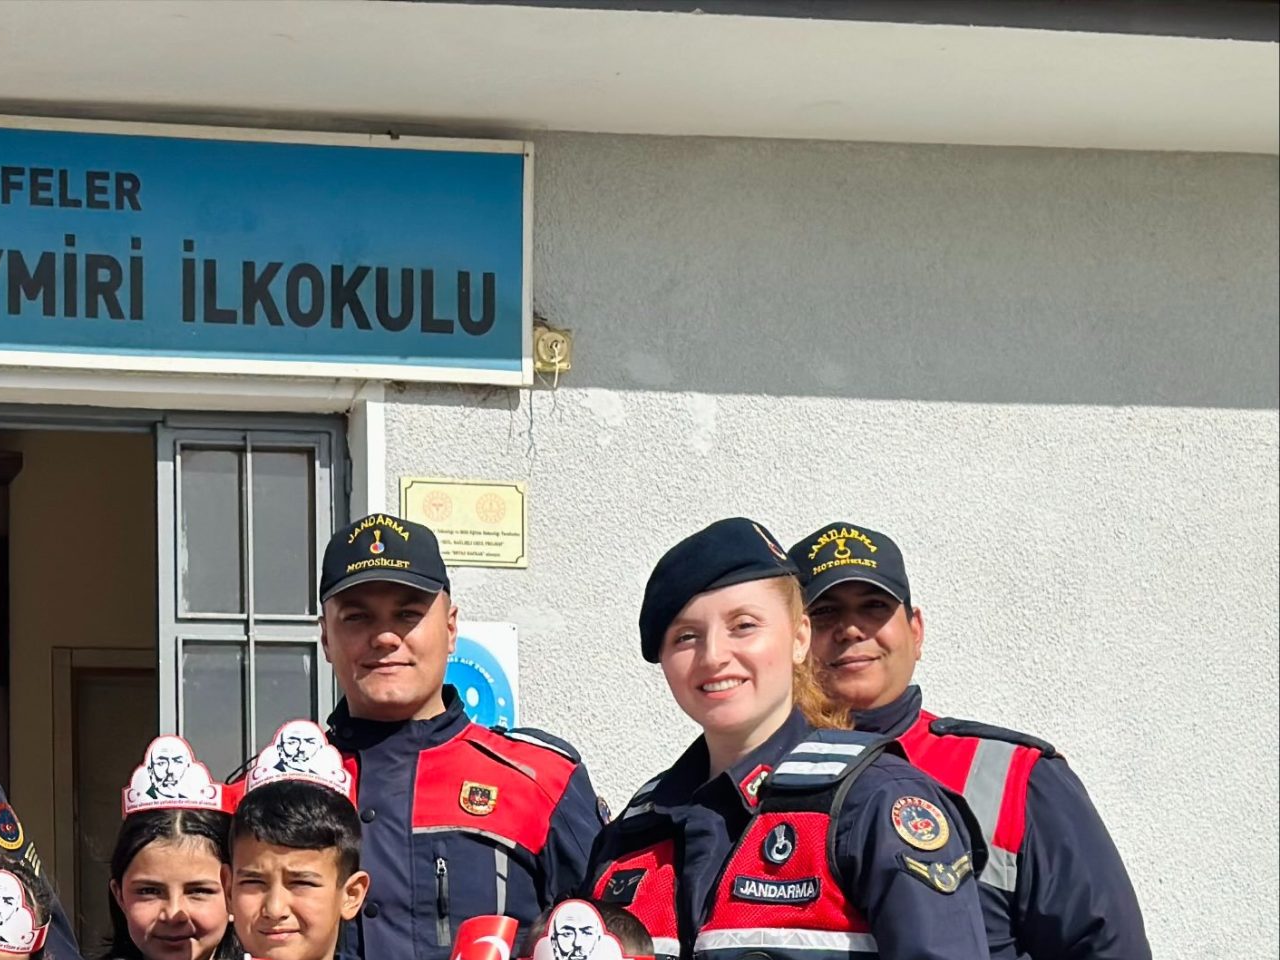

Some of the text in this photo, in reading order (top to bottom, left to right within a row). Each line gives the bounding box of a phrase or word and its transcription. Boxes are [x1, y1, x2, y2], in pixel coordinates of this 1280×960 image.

[181, 239, 496, 336] İLKOKULU
[348, 514, 410, 544] JANDARMA
[808, 527, 878, 560] JANDARMA
[346, 558, 411, 573] MOTOSİKLET
[739, 880, 815, 899] JANDARMA
